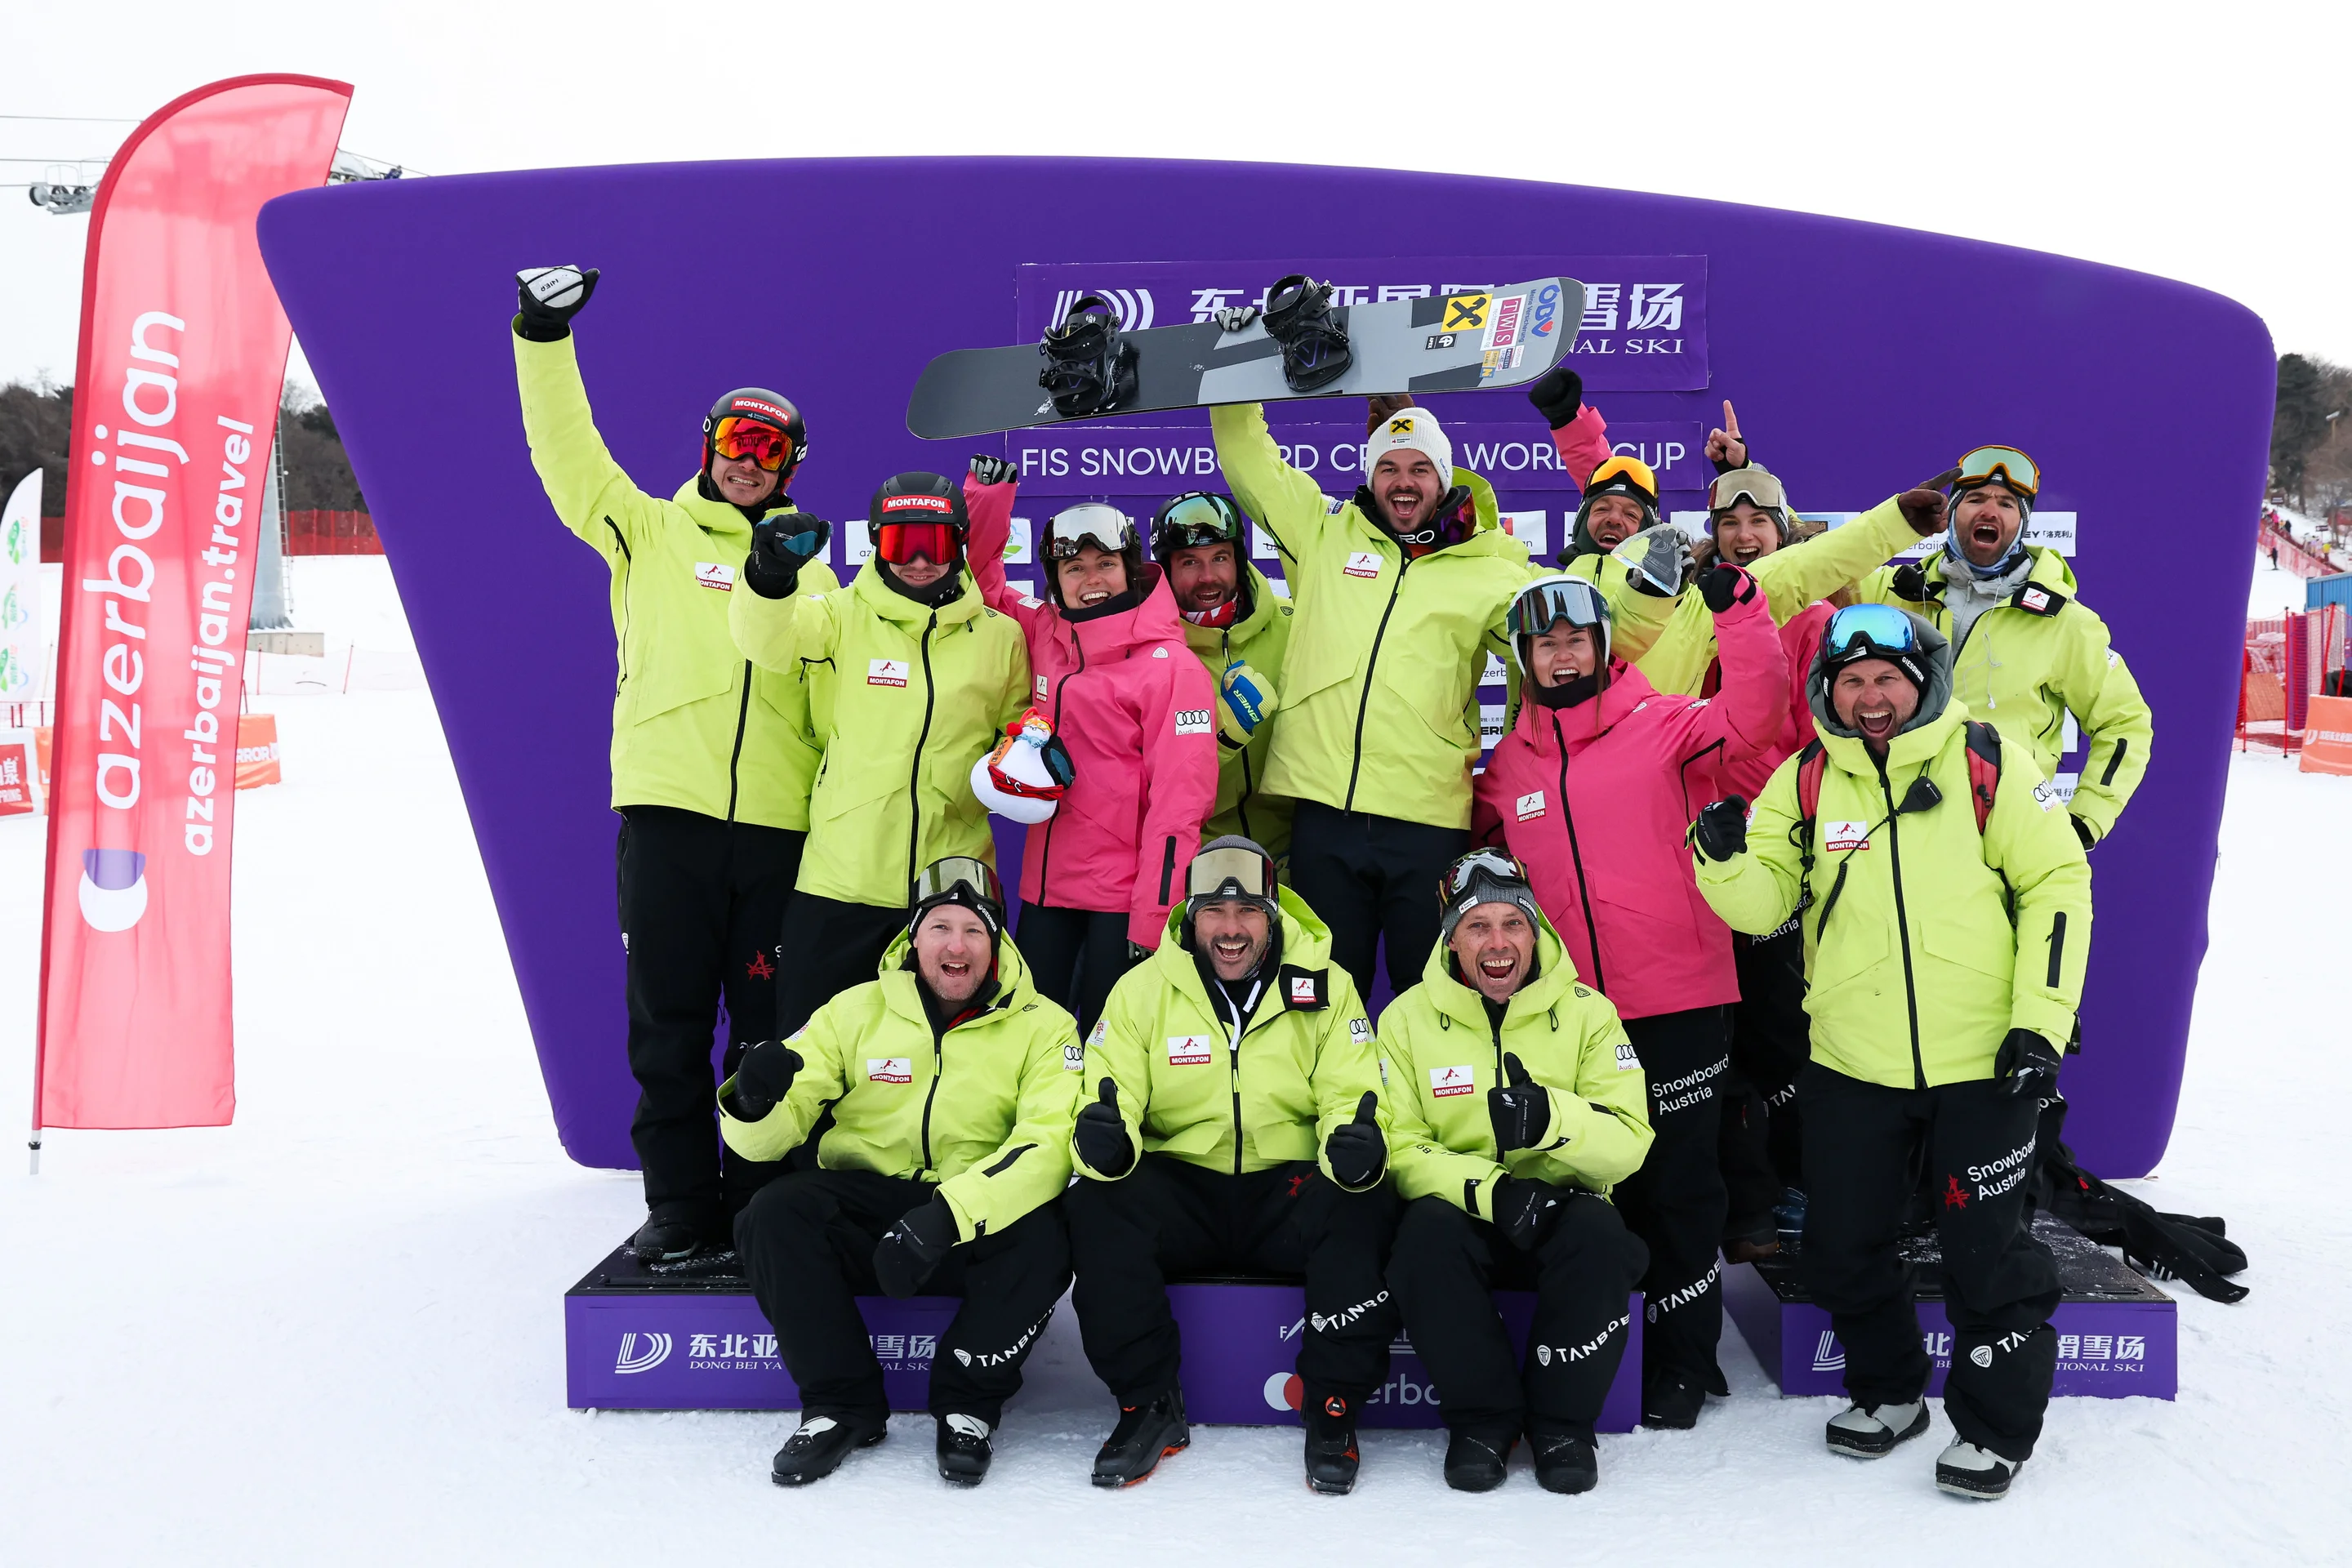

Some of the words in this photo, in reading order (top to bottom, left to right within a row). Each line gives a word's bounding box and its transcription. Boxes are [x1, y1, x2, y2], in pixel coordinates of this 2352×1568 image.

[1495, 299, 1520, 343] TWS
[1624, 338, 1685, 354] SKI
[734, 399, 789, 421] MONTAFON
[1022, 448, 1069, 476] FIS
[1080, 446, 1320, 476] SNOWBRD
[1463, 442, 1566, 471] WORL
[1611, 442, 1686, 470] CUP
[888, 499, 945, 509] MONTAFON
[83, 310, 190, 809] azerbaijan
[1343, 568, 1377, 578] MONTAFON
[182, 415, 254, 857] azerbaijan.travel
[1901, 656, 1925, 683] GIESSWEIN
[868, 677, 905, 687] MONTAFON
[1518, 810, 1546, 822] MONTAFON
[1828, 841, 1870, 851] MONTAFON
[1172, 1056, 1209, 1064] MONTAFON
[871, 1074, 910, 1083] MONTAFON
[1651, 1054, 1730, 1098] Snowboard
[1435, 1086, 1472, 1096] MONTAFON
[1659, 1086, 1713, 1116] Austria
[1978, 1166, 2026, 1201] Austria
[1659, 1258, 1721, 1313] TANBOE
[1327, 1290, 1389, 1330] TANBO
[1556, 1312, 1631, 1363] TANBOE
[689, 1361, 731, 1370] DONG
[735, 1361, 758, 1370] BEI
[762, 1361, 782, 1370] YA
[2114, 1362, 2145, 1373] SKI
